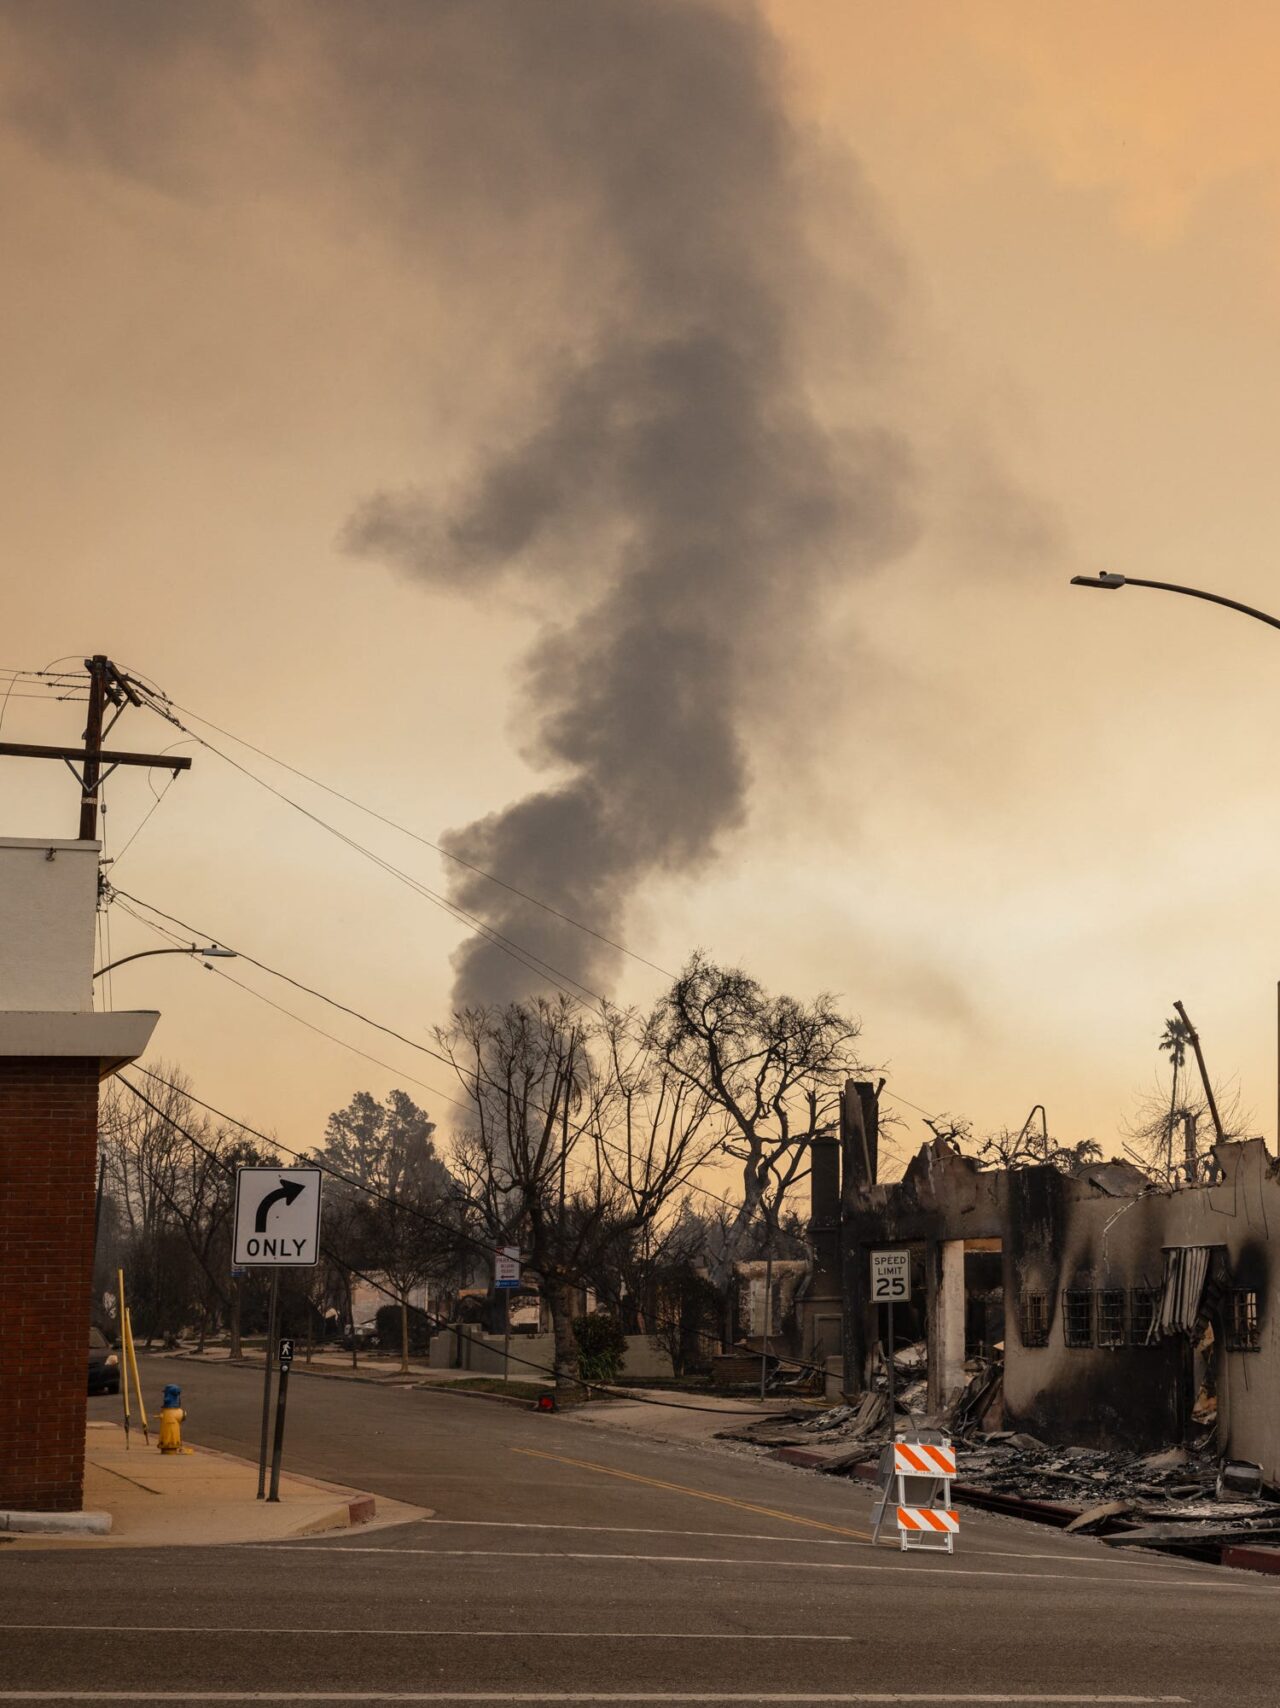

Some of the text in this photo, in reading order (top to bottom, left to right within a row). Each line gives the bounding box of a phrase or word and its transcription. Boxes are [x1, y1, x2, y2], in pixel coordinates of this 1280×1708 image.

[247, 1238, 307, 1257] ONLY
[874, 1256, 906, 1265] SPEED
[878, 1266, 903, 1275] LIMIT
[876, 1277, 905, 1296] 25
